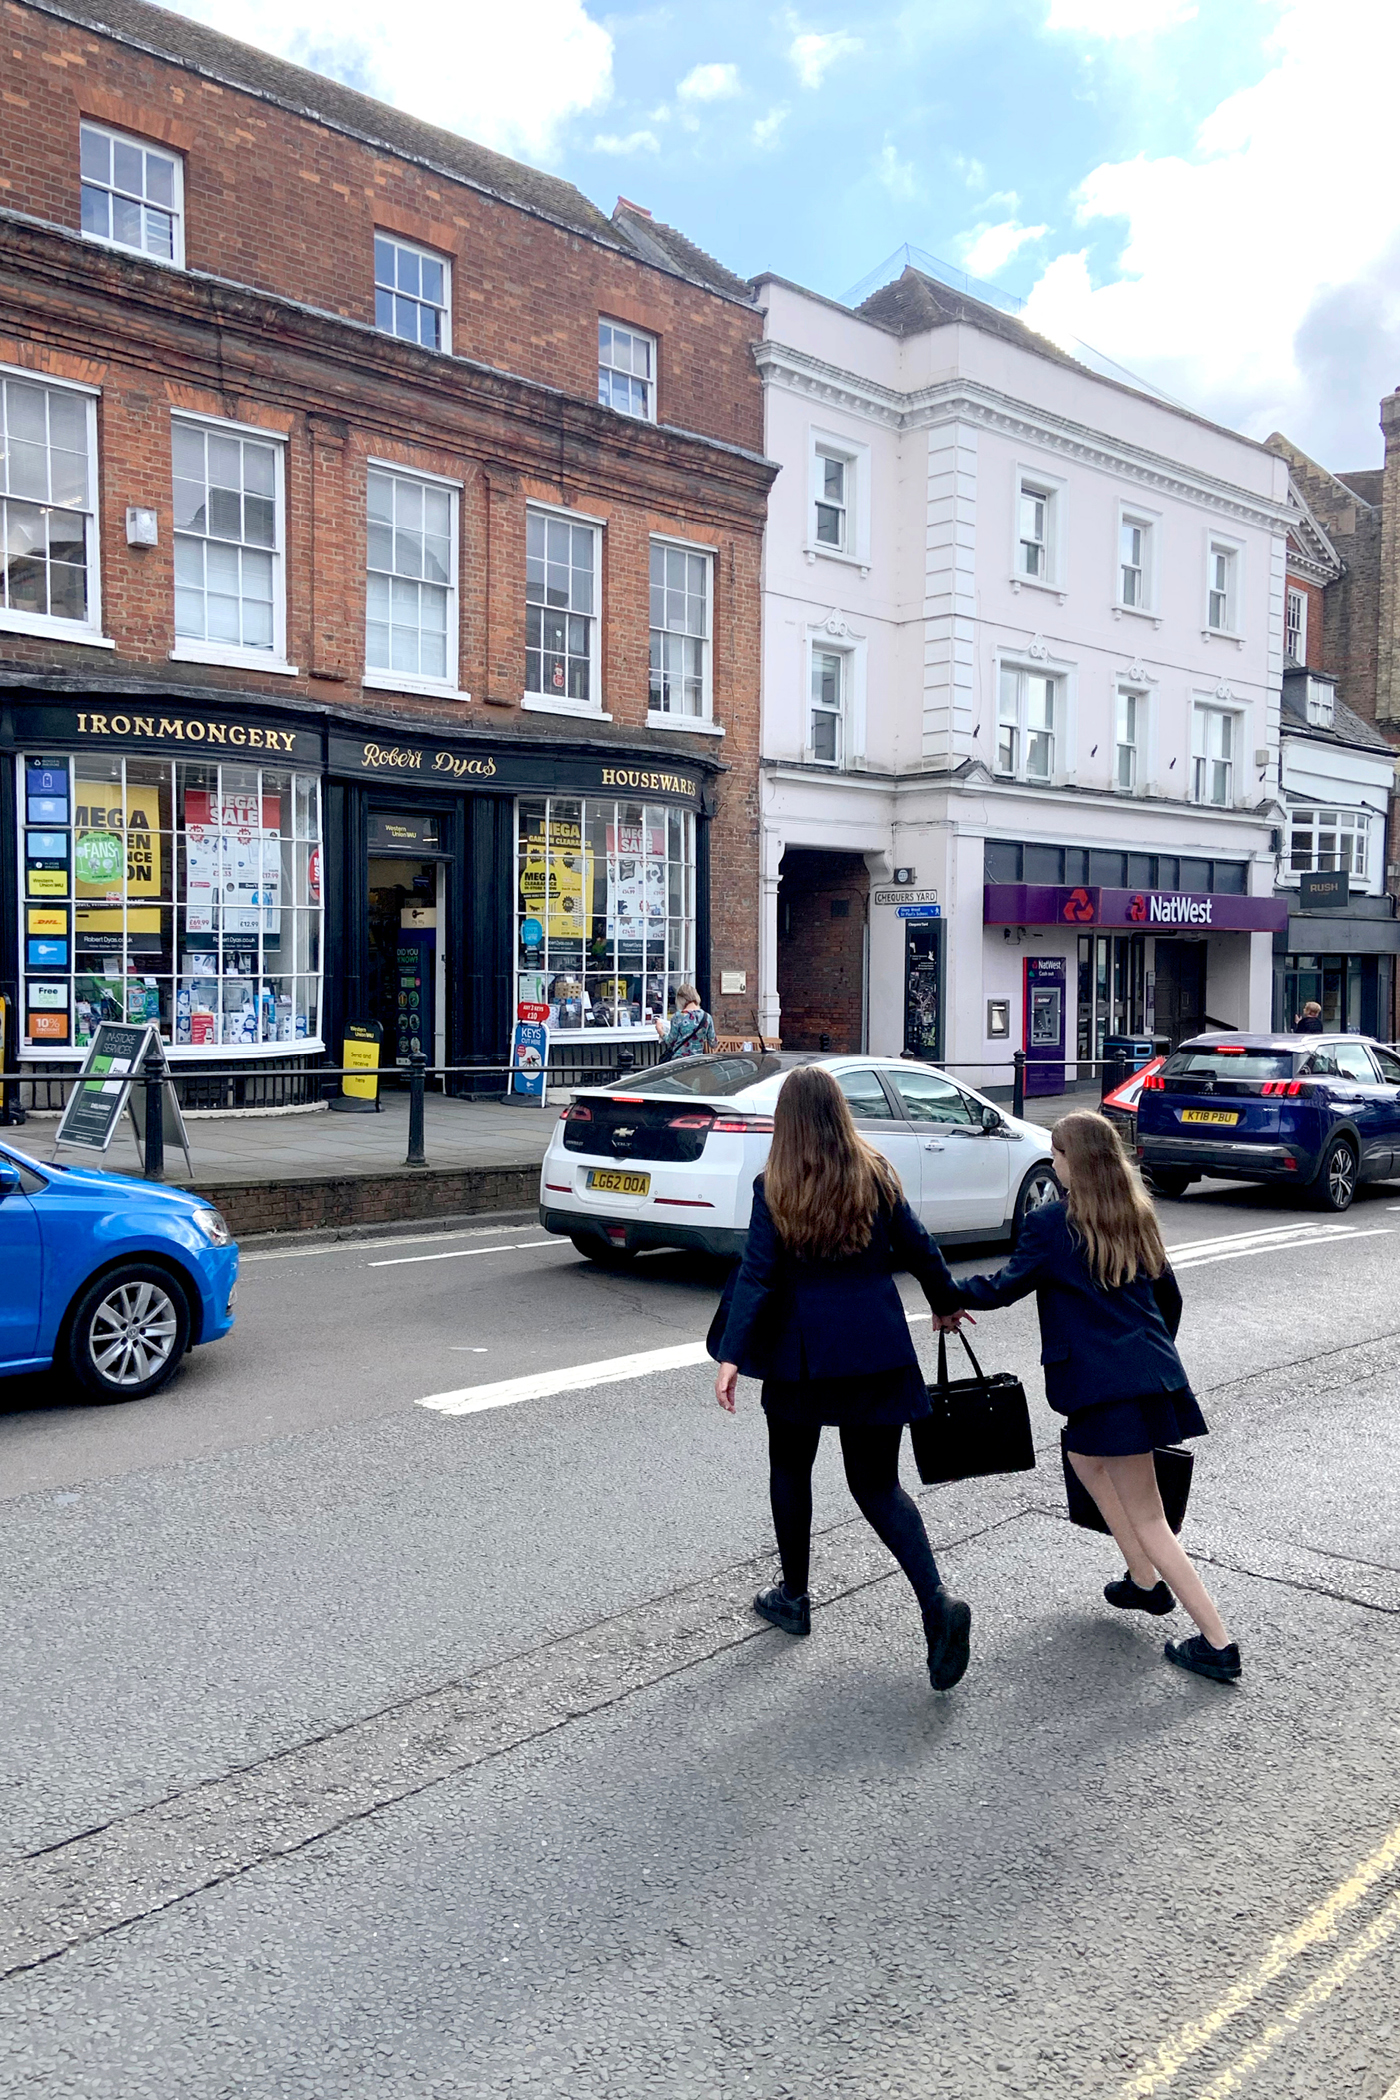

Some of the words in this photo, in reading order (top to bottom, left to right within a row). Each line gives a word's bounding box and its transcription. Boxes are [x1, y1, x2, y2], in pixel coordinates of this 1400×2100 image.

[77, 713, 296, 751] IRONMONGERY
[361, 743, 423, 768] Robert
[431, 752, 497, 779] Dyas
[602, 769, 697, 797] HOUSEWARES
[210, 794, 258, 809] MEGA
[210, 809, 258, 826] SALE
[84, 842, 115, 859] FANS
[1310, 883, 1338, 893] RUSH
[877, 892, 914, 903] CHEQUERS
[916, 891, 936, 901] YARD
[1150, 895, 1213, 923] NatWest
[1038, 960, 1062, 970] NatWest
[39, 987, 58, 995] Free
[36, 1018, 60, 1028] 10%
[106, 1033, 137, 1044] IN-STORE
[521, 1028, 541, 1039] KEYS
[103, 1043, 132, 1054] SERVICES
[1187, 1111, 1209, 1121] KT18
[1211, 1112, 1232, 1122] PBU
[592, 1173, 621, 1190] LG62
